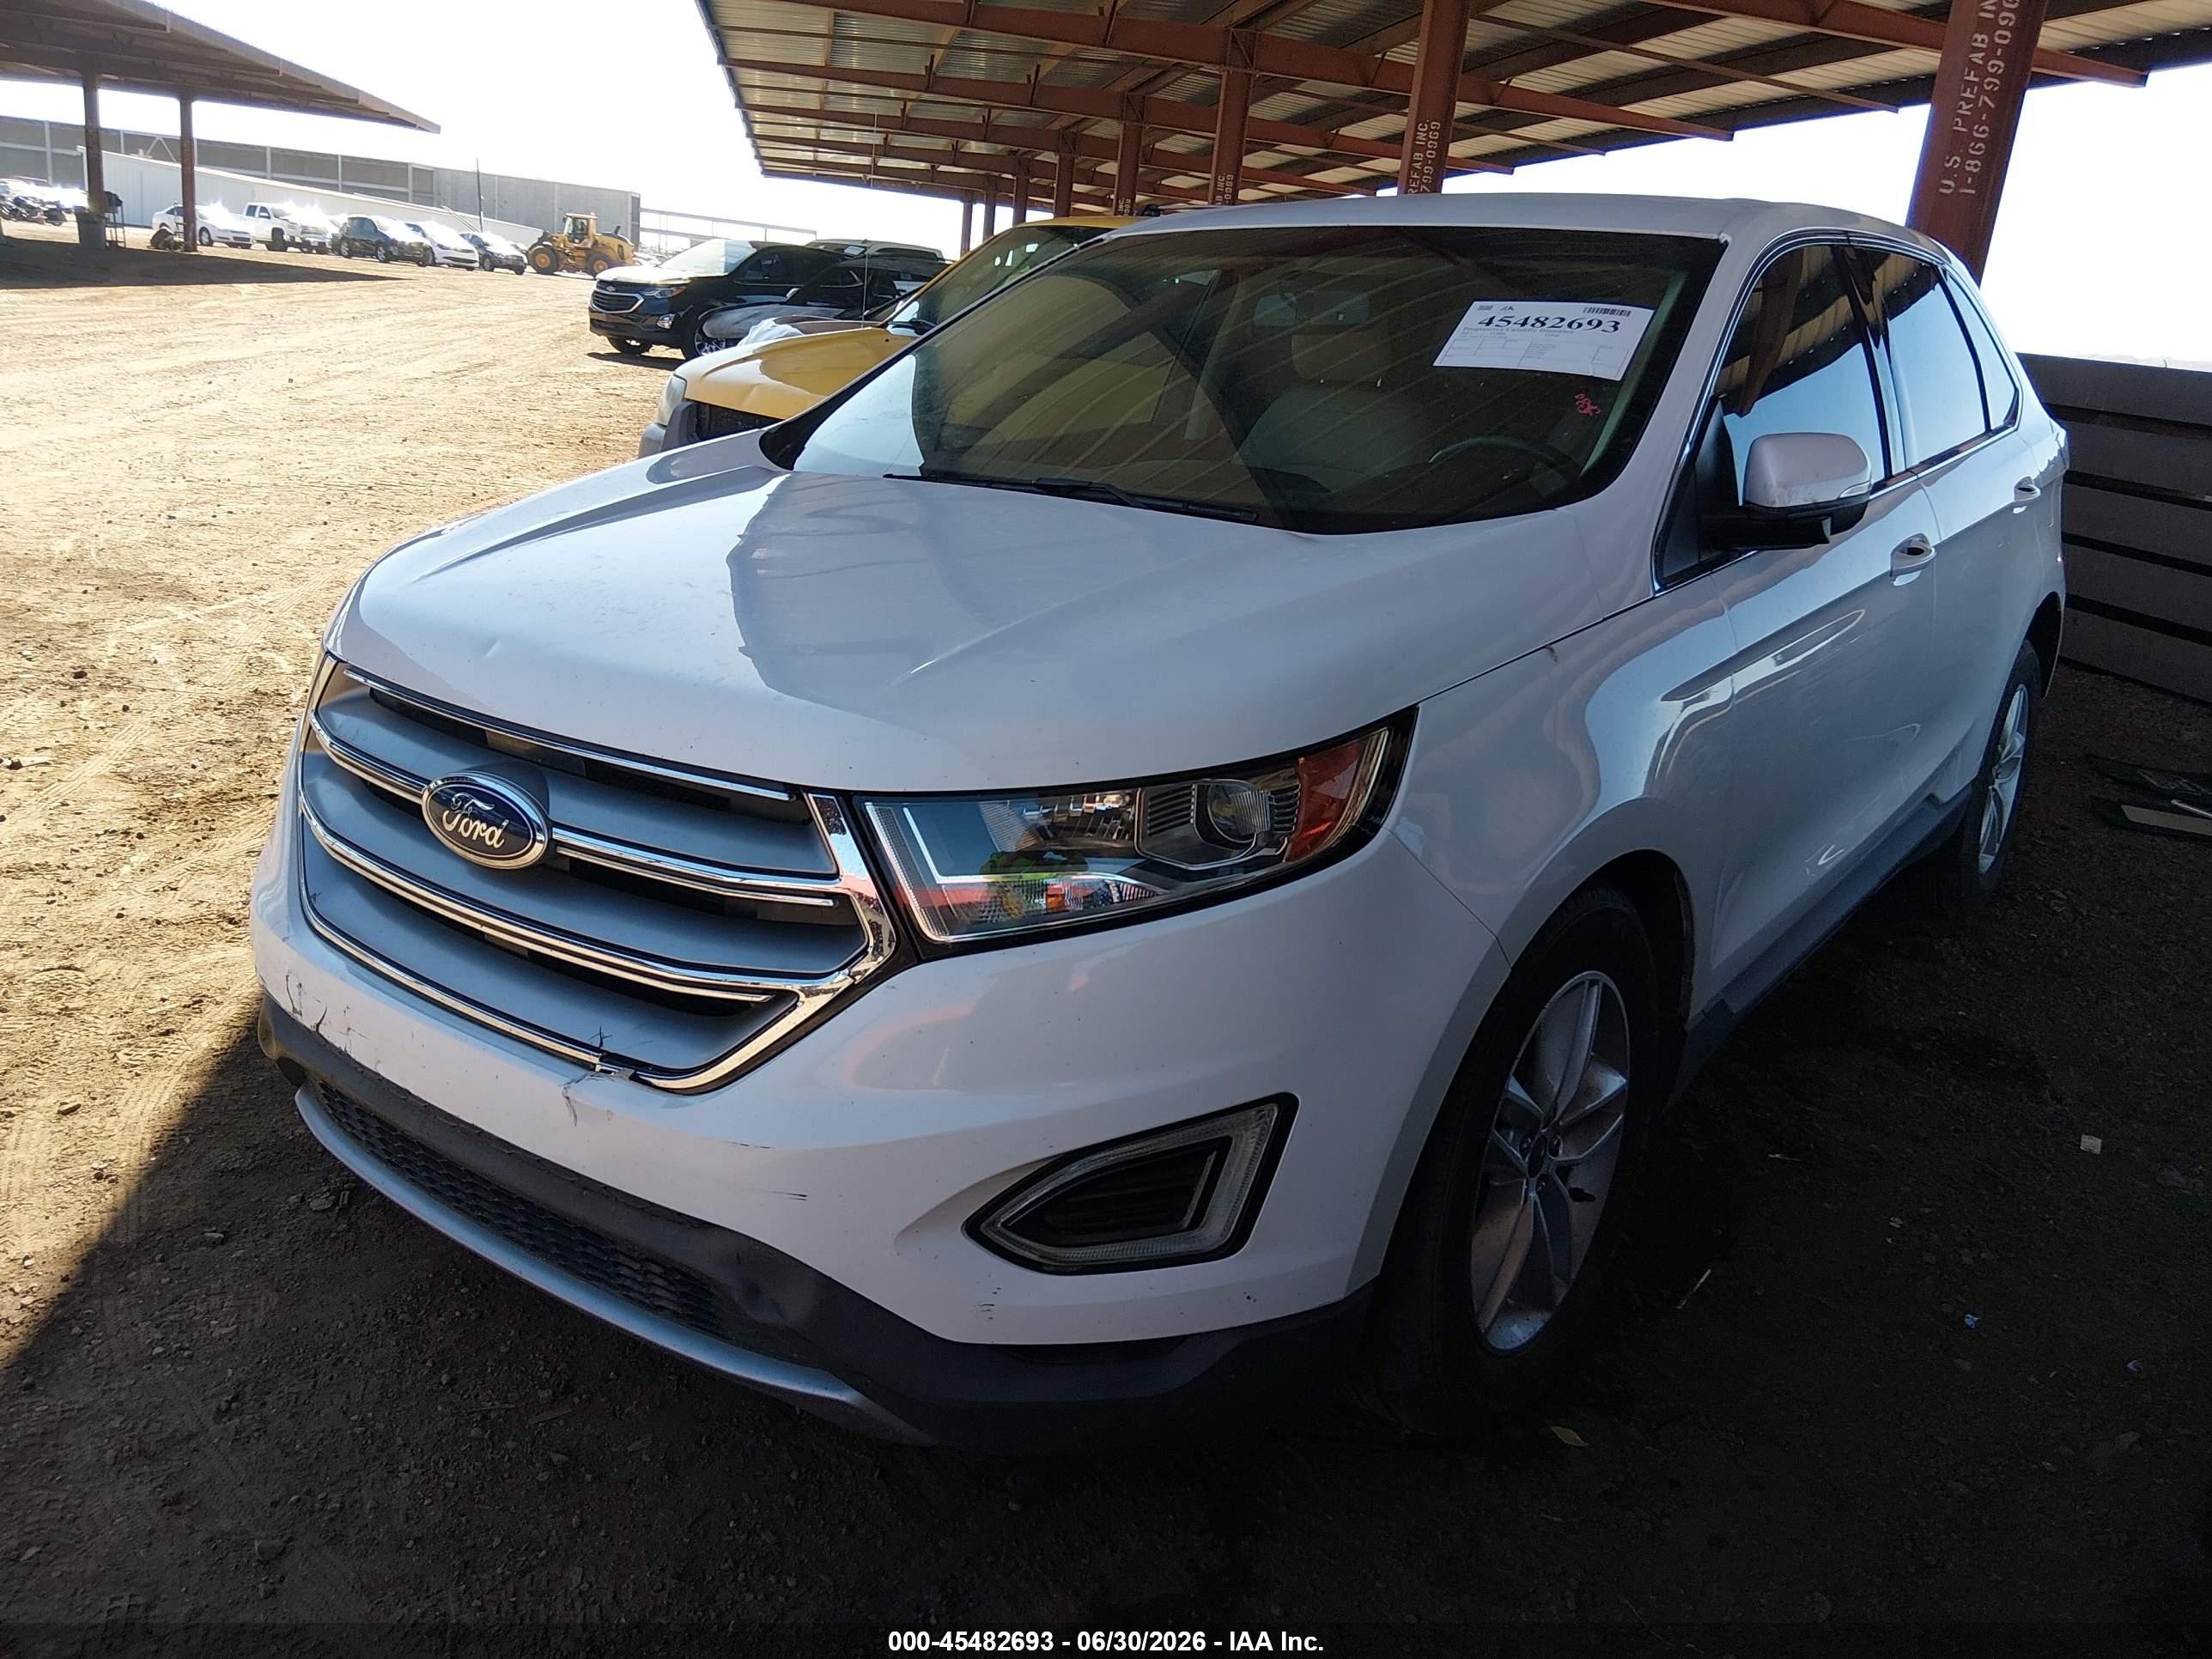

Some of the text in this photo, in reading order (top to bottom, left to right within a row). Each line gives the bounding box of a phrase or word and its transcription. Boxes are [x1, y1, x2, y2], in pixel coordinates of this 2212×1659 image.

[1952, 33, 1989, 132] PREFAB
[1414, 119, 1429, 145] INC.
[1477, 314, 1620, 333] 45482693
[441, 792, 509, 848] Ford
